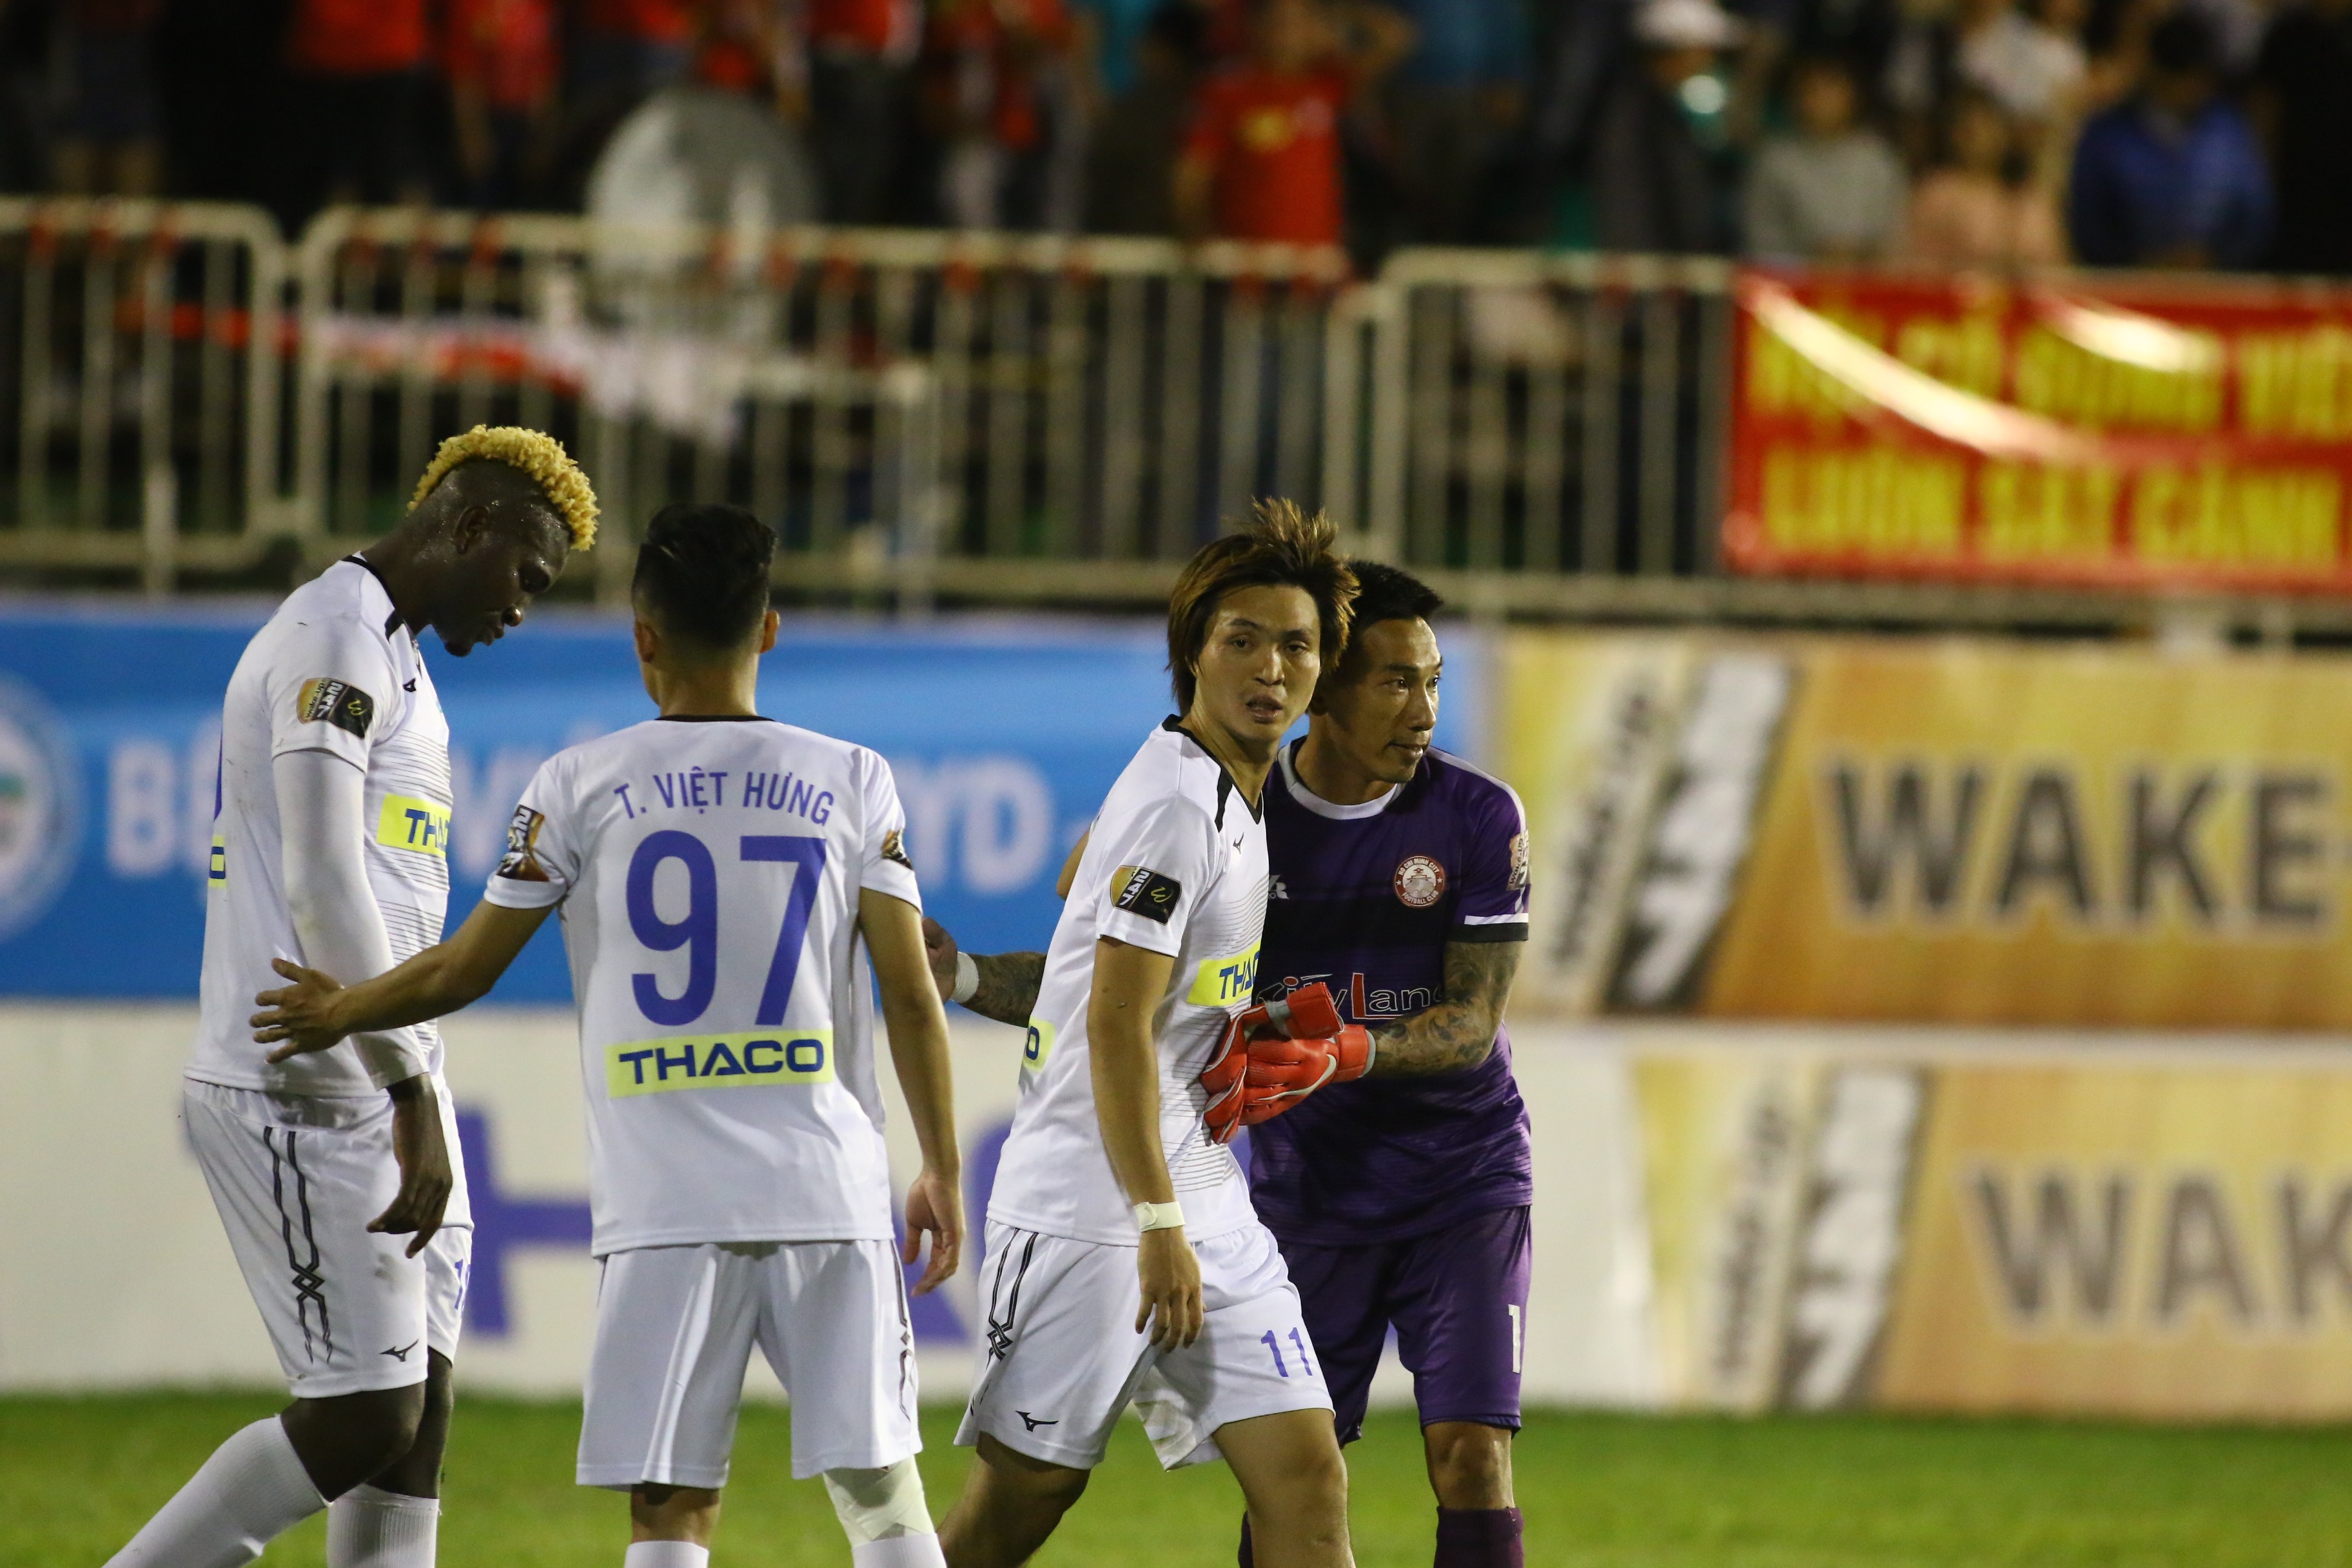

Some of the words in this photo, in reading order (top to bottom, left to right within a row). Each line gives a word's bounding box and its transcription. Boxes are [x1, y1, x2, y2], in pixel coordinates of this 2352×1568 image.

[316, 681, 344, 718] 247
[614, 782, 647, 819] T.
[652, 765, 728, 815] VIỆT
[742, 771, 834, 827] HƯNG
[404, 807, 451, 852] THA
[1828, 752, 2329, 925] WAKE
[1119, 870, 1150, 906] 247
[625, 829, 827, 1026] 97
[618, 1037, 825, 1085] THACO
[1260, 1326, 1313, 1378] 11
[1507, 1304, 1520, 1374] 1
